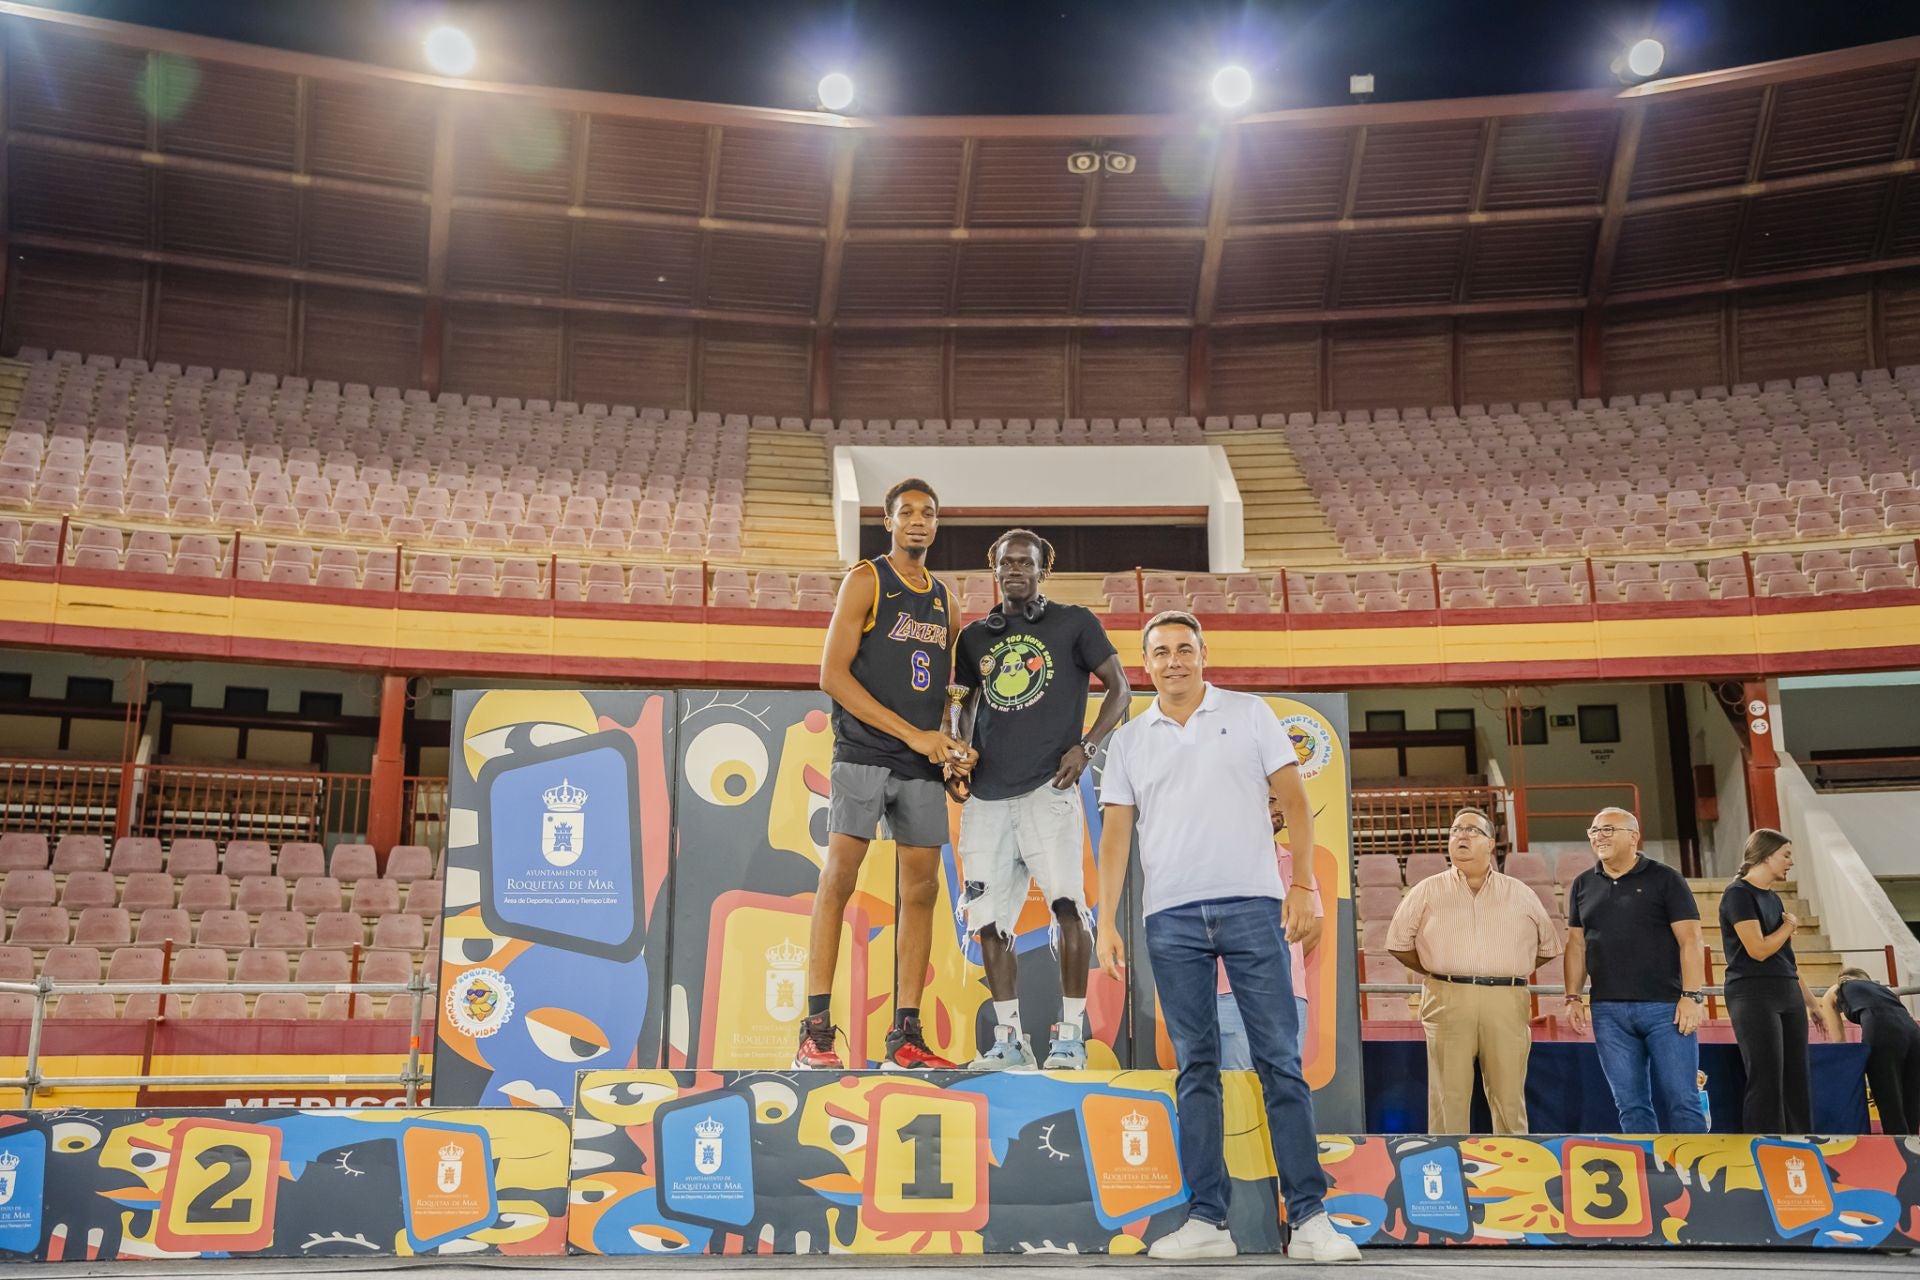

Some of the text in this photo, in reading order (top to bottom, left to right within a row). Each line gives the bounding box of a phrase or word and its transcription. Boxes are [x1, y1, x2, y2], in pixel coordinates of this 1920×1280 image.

[888, 611, 947, 650] LAKERS
[990, 635, 1055, 680] Las 100 Horas son la
[911, 650, 931, 692] 6
[1016, 703, 1024, 711] 37
[1321, 746, 1331, 764] MAR
[526, 869, 598, 877] AYUNTAMIENTO DE
[507, 878, 615, 891] ROQUETAS DE MAR
[526, 897, 554, 905] Deportes,
[581, 896, 602, 905] Tiempo
[603, 896, 617, 904] Libre
[475, 1028, 496, 1036] VIDA
[896, 1114, 954, 1199] 1
[186, 1144, 252, 1223] 2
[673, 1182, 710, 1191] ROQUETAS
[724, 1182, 743, 1190] MAR
[1581, 1158, 1628, 1219] 3
[462, 1199, 479, 1207] MAR
